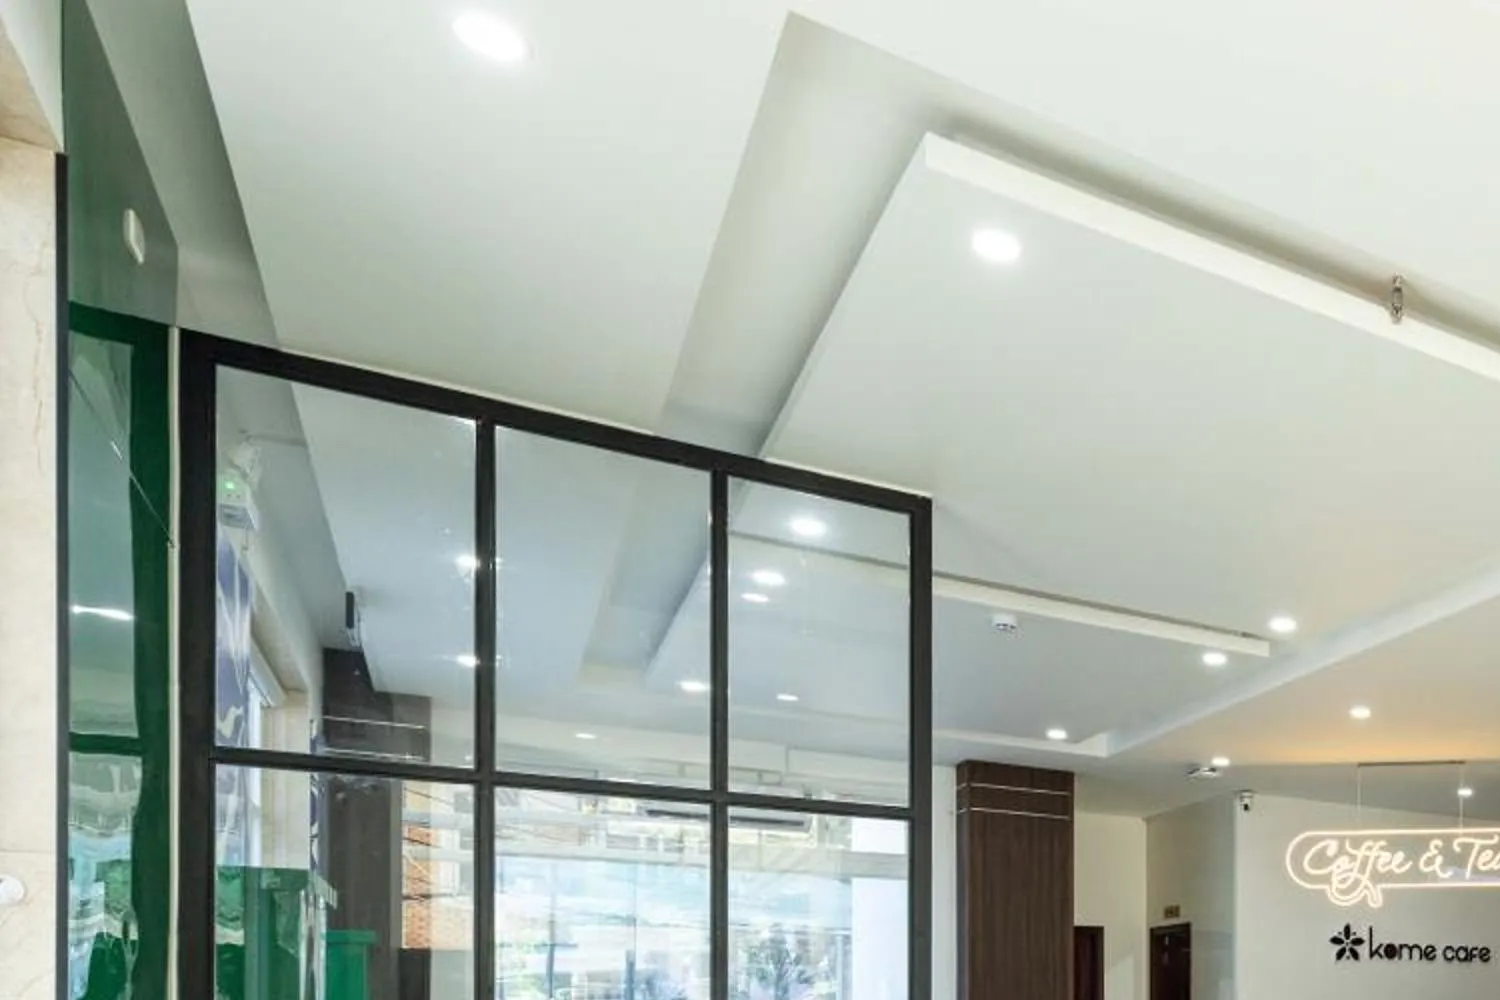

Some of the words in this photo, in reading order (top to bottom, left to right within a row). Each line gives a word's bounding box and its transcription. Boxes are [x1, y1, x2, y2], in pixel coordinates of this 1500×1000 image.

[1303, 836, 1413, 892] Coffee
[1418, 838, 1454, 879] &
[1368, 924, 1437, 962] kome
[1442, 944, 1492, 963] cafe
